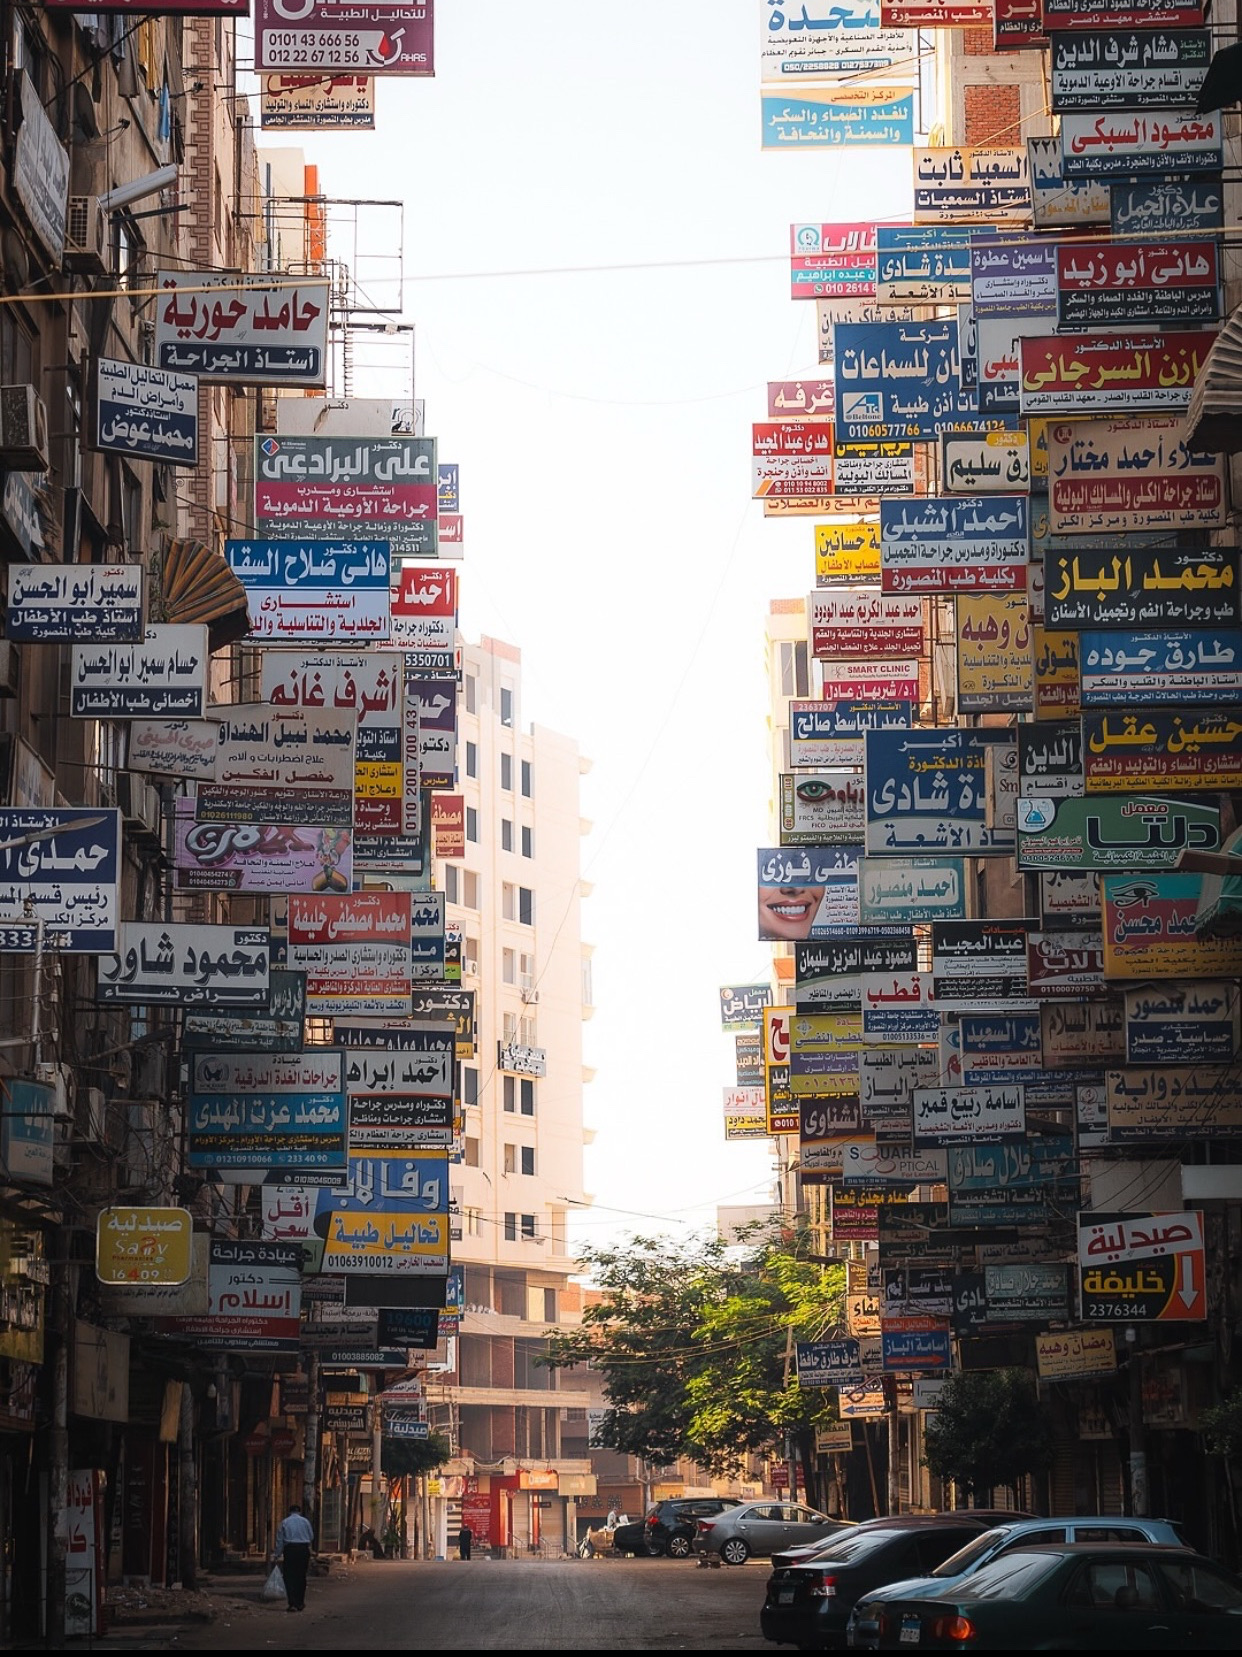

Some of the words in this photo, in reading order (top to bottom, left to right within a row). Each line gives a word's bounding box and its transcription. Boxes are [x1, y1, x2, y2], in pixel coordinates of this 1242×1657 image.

[320, 8, 368, 21] الطبية
[371, 9, 426, 21] للتحاليل
[891, 9, 948, 23] المنصورة
[951, 8, 982, 21] طب
[269, 35, 297, 47] 0101
[301, 35, 315, 47] 43
[319, 35, 341, 47] 666
[345, 35, 359, 47] 56
[1104, 35, 1138, 68] شرف
[1143, 35, 1178, 67] هشام
[269, 51, 290, 62] 012
[292, 51, 307, 62] 22
[311, 51, 325, 62] 67
[329, 51, 341, 62] 12
[345, 51, 359, 62] 56
[1057, 38, 1100, 69] الدين
[777, 127, 842, 144] والنحافة
[845, 127, 901, 143] والسمنة
[1071, 116, 1147, 153] السبكى
[1151, 121, 1214, 150] محمود
[918, 150, 964, 187] ثابت
[970, 155, 1028, 186] السعيد
[918, 191, 985, 209] السمعيات
[990, 189, 1030, 205] أستاذ
[881, 253, 931, 281] شادى
[1063, 251, 1112, 288] زيد
[1116, 247, 1145, 286] أبو
[1151, 249, 1211, 284] هانى
[826, 284, 844, 293] 010
[846, 284, 870, 293] 2614
[163, 279, 248, 341] حورية
[252, 290, 321, 331] حامد
[899, 324, 950, 344] شركة
[167, 345, 248, 373] الجراحة
[254, 348, 314, 371] أستاذ
[842, 347, 930, 381] للسماعات
[112, 385, 139, 400] الدم
[139, 390, 184, 411] وأمراض
[932, 390, 953, 417] أذن
[891, 393, 930, 418] طبية
[754, 431, 783, 454] المجيد
[848, 424, 921, 438] 01060577766
[783, 436, 803, 454] عبد
[804, 433, 829, 453] هدى
[262, 446, 369, 482] البرادعى
[373, 446, 430, 480] على
[950, 450, 1002, 486] سليم
[343, 483, 395, 495] استشارى
[262, 494, 319, 515] الدموية
[322, 494, 379, 516] الأوعية
[382, 494, 430, 516] جراحة
[956, 499, 983, 510] دكتور
[964, 499, 1023, 533] أحمد
[882, 504, 957, 542] الشبلى
[230, 547, 280, 576] السقا
[884, 544, 920, 564] التجميل
[920, 544, 953, 563] جراحة
[956, 544, 990, 563] ومدرس
[990, 540, 1025, 562] دكتوراة
[284, 547, 338, 585] صلاح
[341, 545, 388, 585] هانى
[1143, 557, 1234, 591] محمد
[69, 568, 95, 606] أبو
[403, 571, 451, 605] أحمد
[892, 568, 946, 591] المنصورة
[948, 568, 976, 589] طب
[978, 566, 1016, 588] بكلية
[1051, 555, 1133, 602] الباز
[12, 575, 68, 606] الحسن
[93, 583, 138, 606] سمير
[260, 592, 355, 611] استشارى
[12, 609, 67, 626] الأطفال
[71, 609, 97, 627] طب
[103, 608, 138, 623] أستاذ
[1051, 601, 1091, 622] الأسنان
[1092, 602, 1136, 621] وتجميل
[1139, 602, 1164, 621] الفم
[277, 612, 335, 636] والتناسلية
[338, 613, 387, 636] الجلدية
[78, 648, 117, 683] الحسن
[117, 645, 135, 683] أبو
[168, 648, 199, 682] حسام
[1087, 646, 1157, 672] جوده
[1164, 639, 1235, 670] طارق
[137, 655, 165, 683] سمير
[847, 666, 879, 674] SMART
[880, 664, 911, 673] CLINIC
[77, 691, 124, 711] الأطفال
[126, 692, 150, 712] طب
[153, 690, 199, 711] أخصائى
[334, 664, 398, 723] أشرف
[798, 703, 833, 712] 2363707
[274, 722, 307, 748] نبيل
[313, 726, 352, 746] محمد
[1088, 715, 1158, 753] عقل
[1167, 716, 1242, 753] حسين
[873, 771, 950, 815] شادى
[1120, 802, 1169, 816] معمل
[1086, 815, 1219, 850] دلتا
[17, 837, 109, 878] حمدى
[762, 852, 811, 883] فوزى
[65, 886, 108, 911] رئيس
[236, 933, 268, 944] دكتور
[937, 935, 991, 956] المجيد
[995, 935, 1023, 955] عبد
[101, 931, 174, 984] شاور
[183, 945, 268, 987] محمود
[413, 993, 471, 1013] دكتور
[867, 976, 922, 1010] قطب
[402, 1053, 447, 1085] أحمد
[287, 1153, 303, 1163] 233
[304, 1153, 316, 1163] 40
[316, 1153, 328, 1163] 90
[107, 1213, 183, 1237] صيدلية
[335, 1217, 380, 1251] طبية
[384, 1218, 440, 1251] تحاليل
[212, 1243, 256, 1263] جراحة
[257, 1246, 297, 1262] عيادة
[1087, 1223, 1193, 1262] صيدلية
[328, 1255, 393, 1269] 01063910012
[228, 1273, 264, 1286] دكتور
[1083, 1270, 1166, 1299] خليفة
[219, 1289, 291, 1316] إسلام
[1089, 1303, 1147, 1318] 2376344
